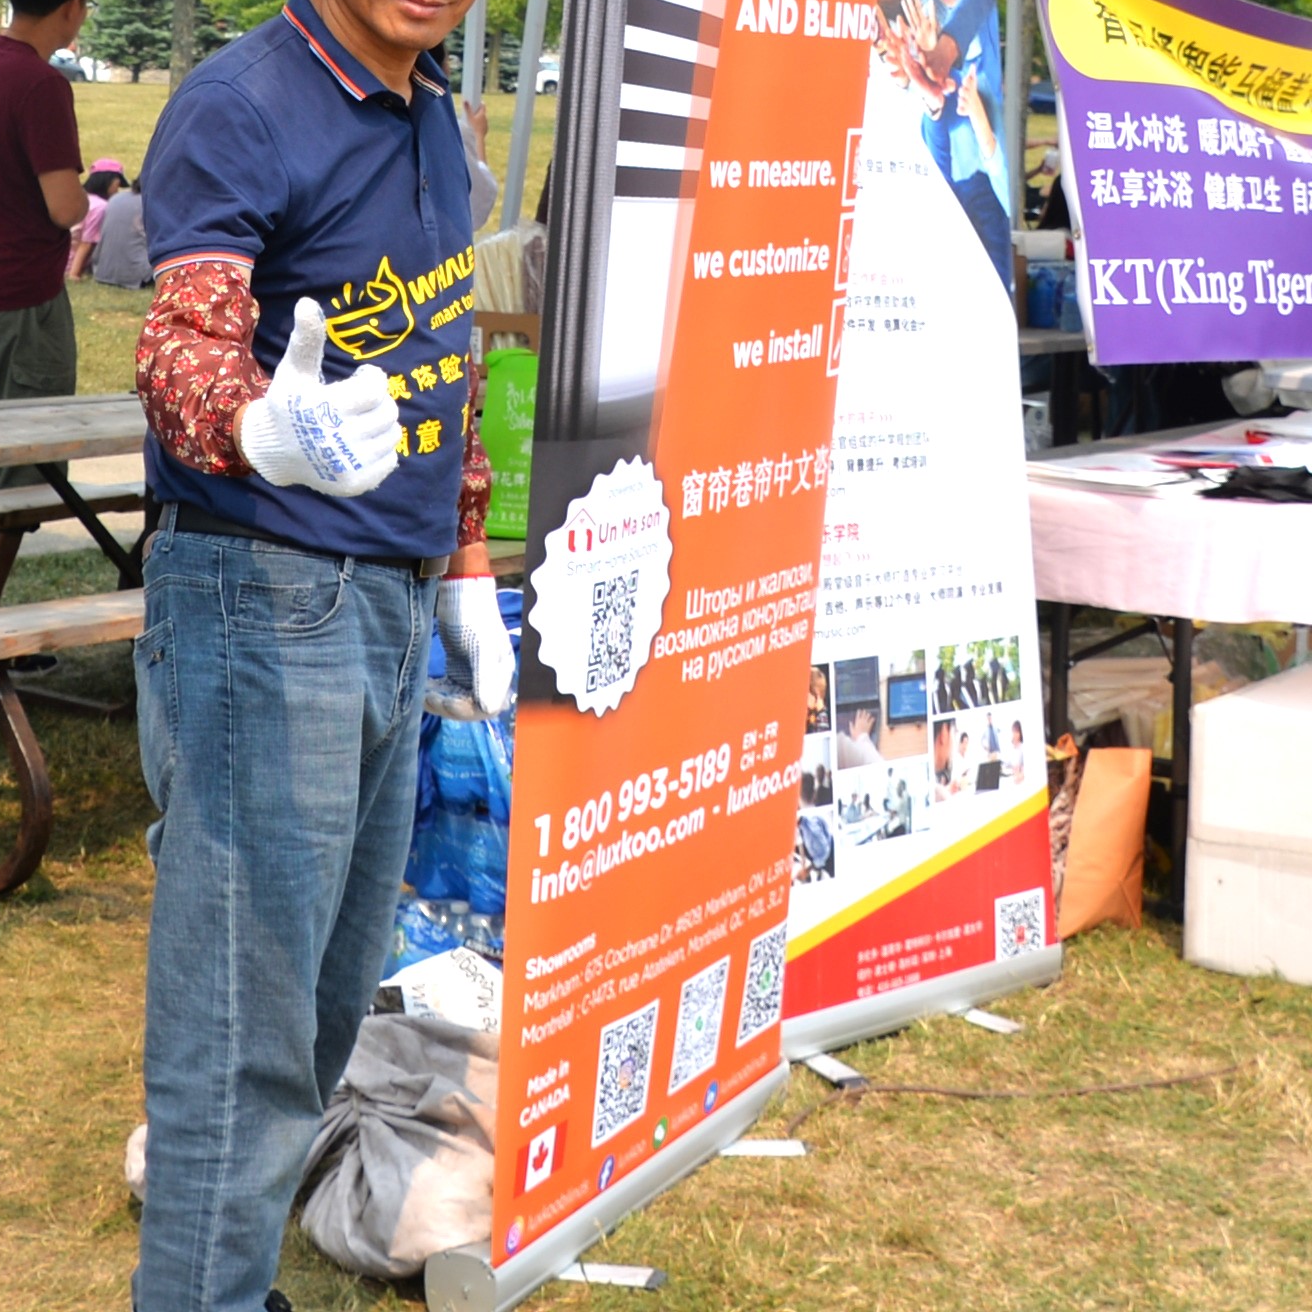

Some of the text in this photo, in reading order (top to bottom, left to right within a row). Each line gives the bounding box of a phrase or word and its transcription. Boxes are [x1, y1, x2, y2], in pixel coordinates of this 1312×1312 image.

[803, 0, 880, 41] BLINDS
[1086, 110, 1275, 161] 温水冲洗 暖风烘干
[710, 157, 837, 189] we measure.
[1090, 168, 1194, 209] 私享沐浴
[1204, 171, 1284, 214] 健康卫生
[407, 245, 475, 305] WHALE
[693, 242, 831, 280] we customize
[1090, 258, 1247, 316] KT(King
[430, 302, 463, 331] smart
[732, 324, 824, 369] we install
[685, 584, 744, 620] Шторы
[745, 580, 756, 602] и
[654, 614, 739, 660] возможна
[682, 618, 810, 683] на русском языке
[739, 742, 778, 772] CH RU
[742, 721, 779, 751] EN FR
[535, 742, 731, 858] 1 800 993-5189
[531, 806, 705, 905] info@luxkoo.com
[523, 972, 583, 1015] Markham:
[604, 933, 659, 970] Cochrane
[525, 931, 597, 981] Showrooms
[618, 971, 641, 996] rue
[527, 1058, 571, 1099] Made in
[519, 1083, 571, 1129] CANADA
